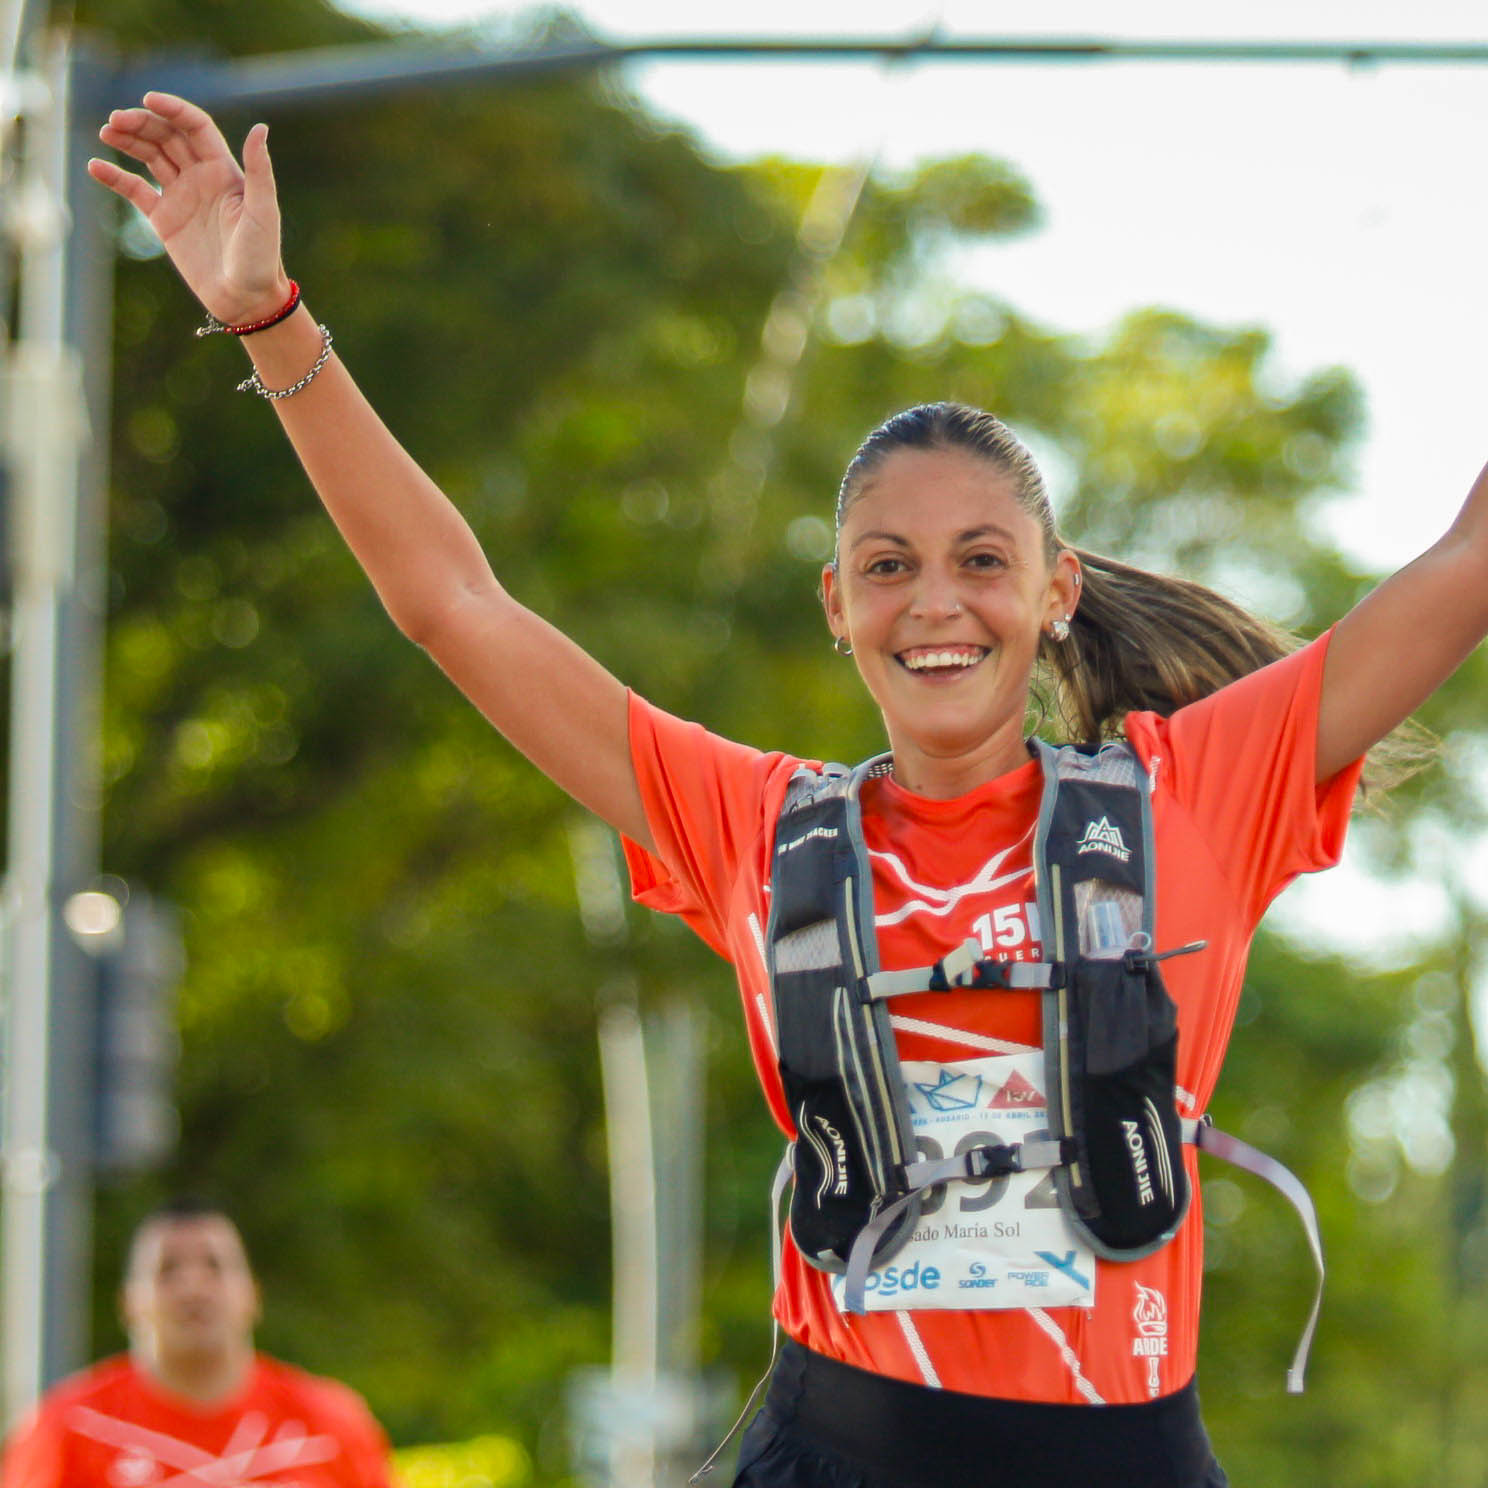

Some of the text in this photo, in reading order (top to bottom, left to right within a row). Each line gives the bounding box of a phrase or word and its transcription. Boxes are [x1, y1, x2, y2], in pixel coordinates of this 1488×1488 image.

[1077, 841, 1130, 862] AONIJIE
[814, 1115, 848, 1195] AONIJIE
[1120, 1120, 1155, 1206] AONIJIE
[943, 1221, 989, 1240] María
[993, 1221, 1021, 1238] Sol
